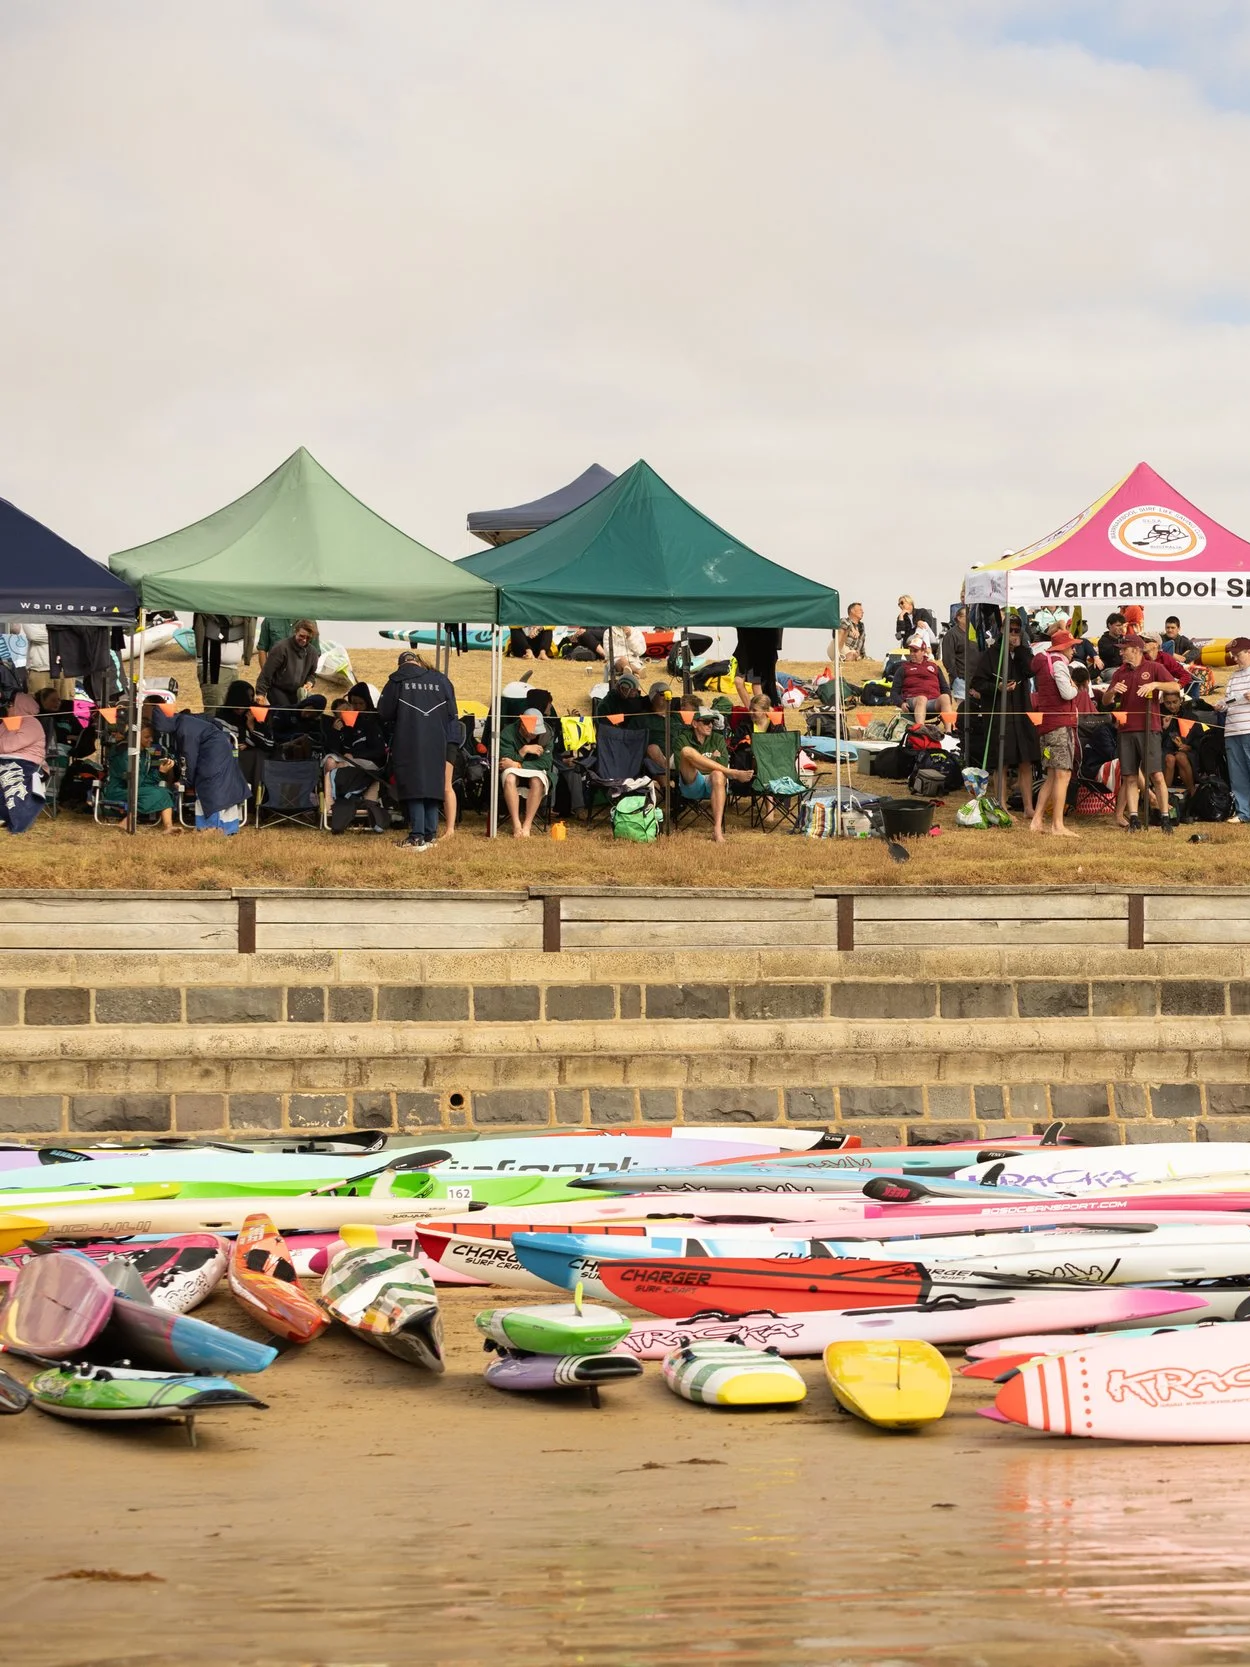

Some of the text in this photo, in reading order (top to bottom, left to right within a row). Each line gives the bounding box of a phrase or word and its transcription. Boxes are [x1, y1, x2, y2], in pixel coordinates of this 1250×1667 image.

[1039, 577, 1216, 598] Warrnambool
[20, 602, 107, 612] Wanderer
[449, 1188, 471, 1199] 162
[465, 1257, 495, 1267] SURF
[620, 1269, 712, 1285] CHARGER
[635, 1285, 699, 1295] SURF CRAFT
